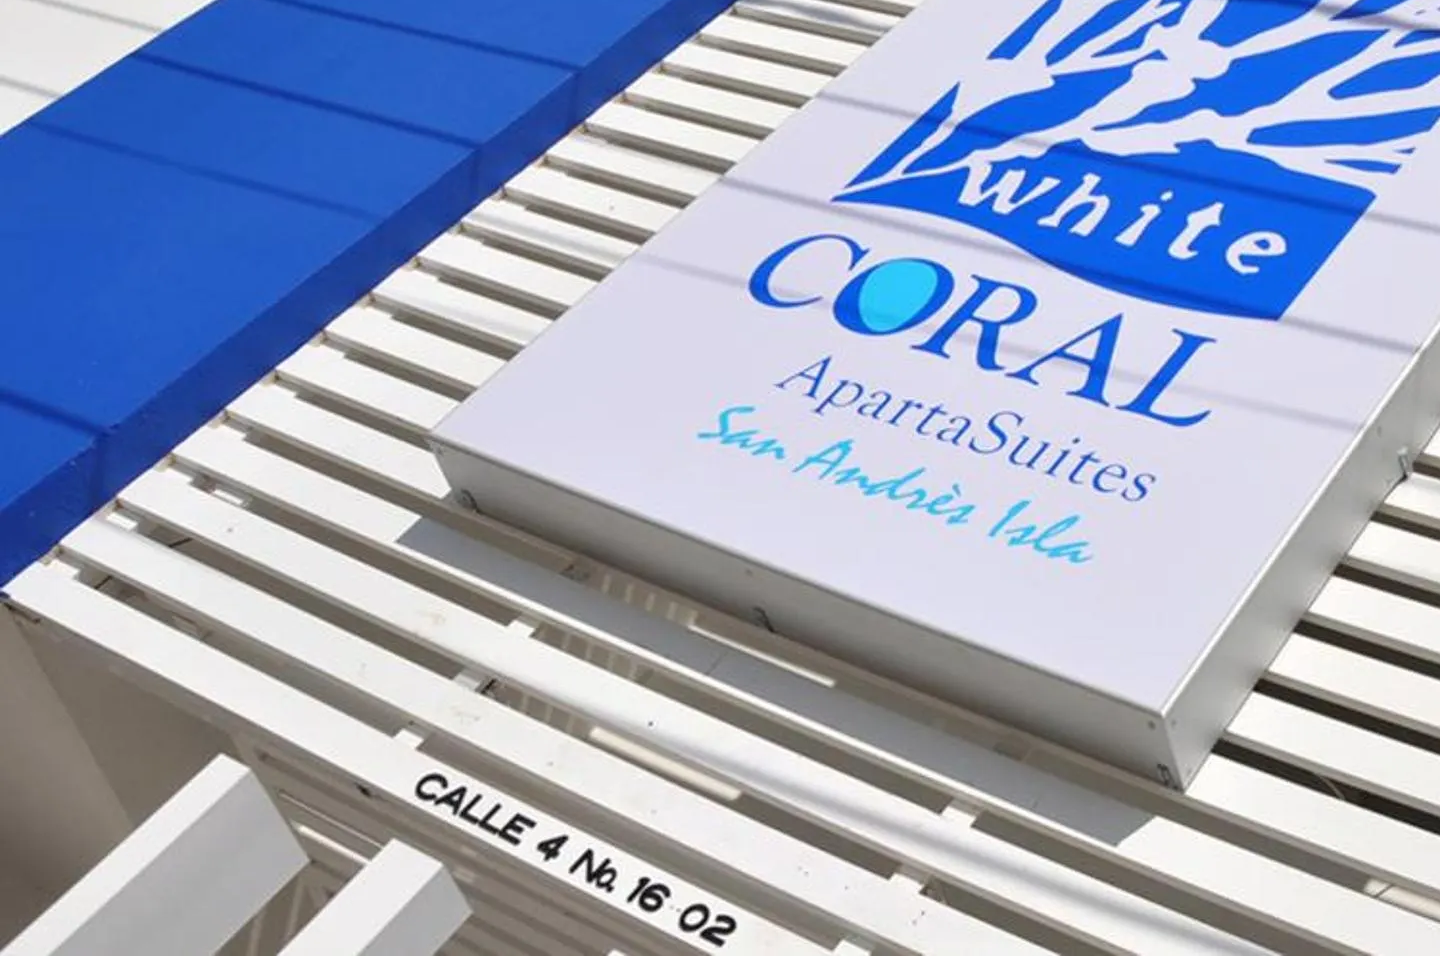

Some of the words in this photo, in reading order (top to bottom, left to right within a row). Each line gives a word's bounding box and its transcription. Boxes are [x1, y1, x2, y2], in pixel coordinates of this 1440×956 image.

[960, 159, 1287, 275] white
[748, 234, 1217, 428] CORAL
[698, 405, 786, 461] San
[989, 500, 1095, 564] Isla
[777, 355, 1157, 504] ApartaSuites
[415, 773, 536, 846] CALLE
[537, 835, 569, 862] 4
[627, 877, 671, 912] 16
[678, 904, 737, 946] 02
